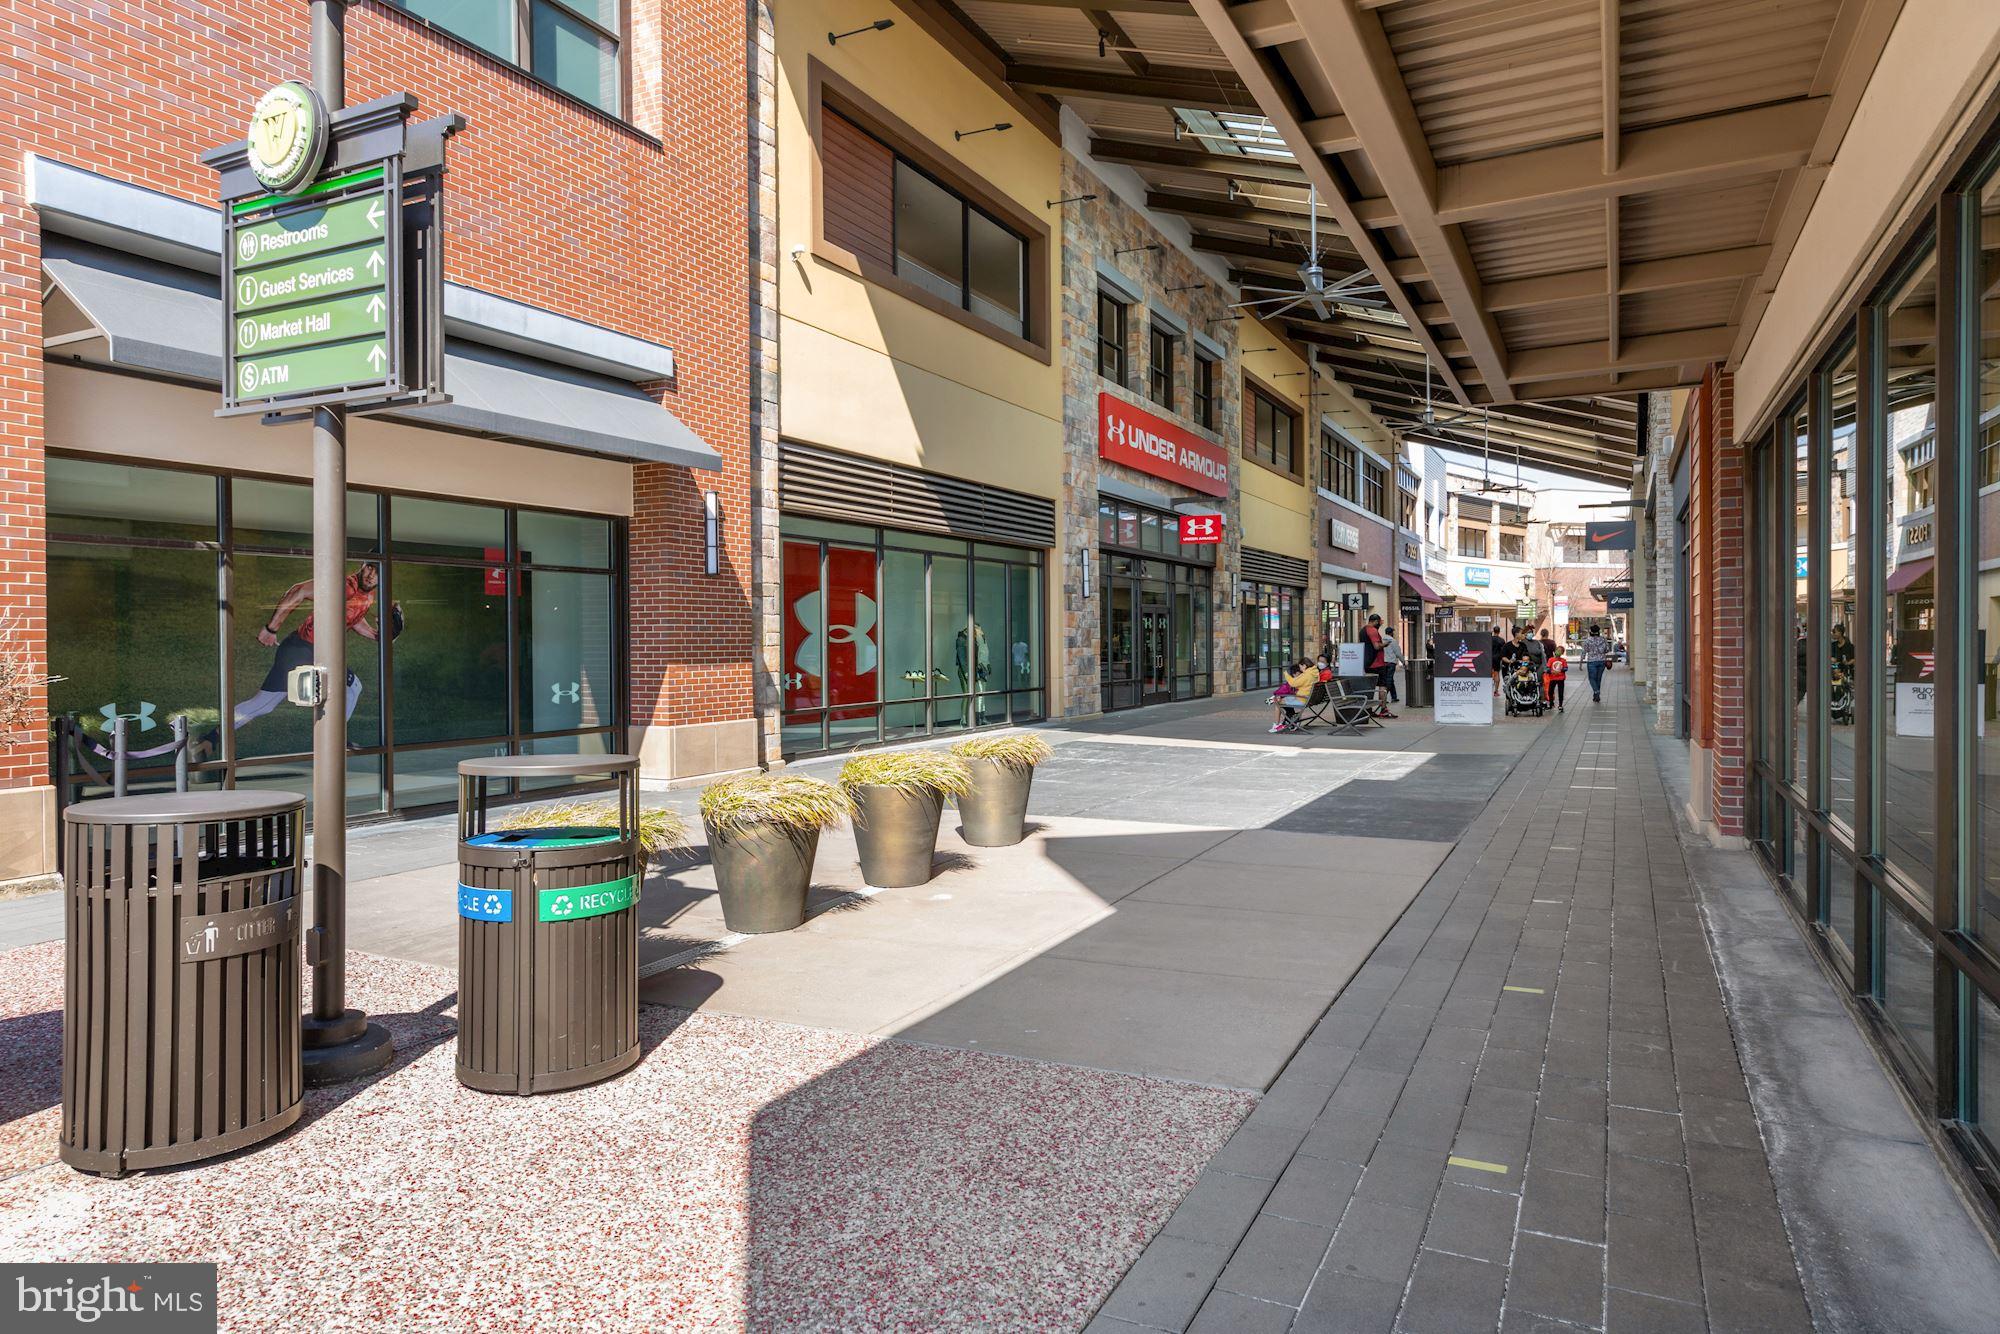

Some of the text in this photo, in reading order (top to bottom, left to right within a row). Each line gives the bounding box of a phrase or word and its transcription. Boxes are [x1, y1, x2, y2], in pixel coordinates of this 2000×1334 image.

[260, 223, 328, 251] Restrooms
[260, 267, 354, 298] Guest Services
[260, 312, 331, 341] Market Hall
[261, 365, 289, 386] ATM
[1128, 424, 1227, 483] UNDER ARMOUR
